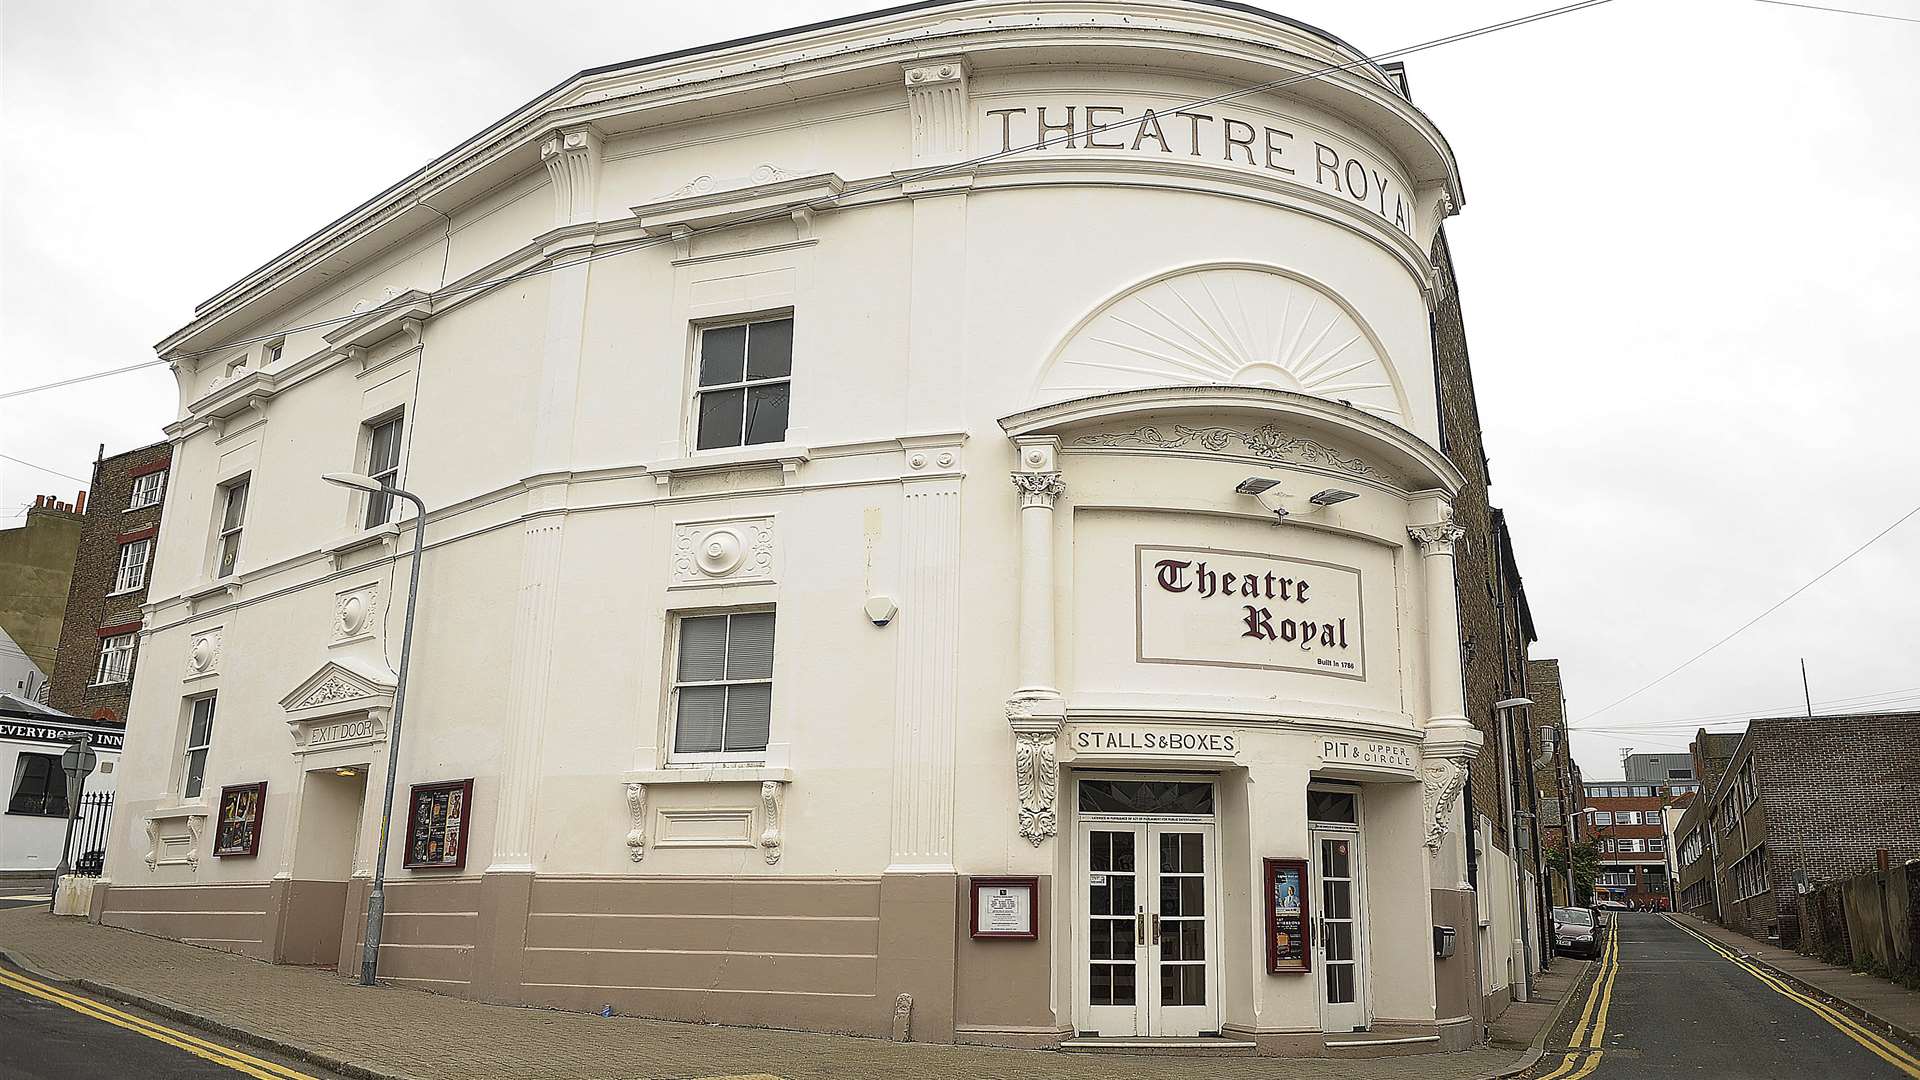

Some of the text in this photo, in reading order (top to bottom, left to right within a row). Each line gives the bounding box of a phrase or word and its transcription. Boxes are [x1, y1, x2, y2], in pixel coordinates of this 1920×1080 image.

[986, 106, 1296, 175] THEATRE
[1154, 559, 1310, 603] Theatre
[1241, 605, 1348, 650] Royal
[1317, 658, 1332, 666] Built
[97, 734, 123, 746] INN
[311, 720, 372, 744] EXIT DOOR
[1324, 741, 1360, 759] PIT &
[1363, 752, 1410, 766] CIRCLE
[1368, 744, 1406, 756] UPPER
